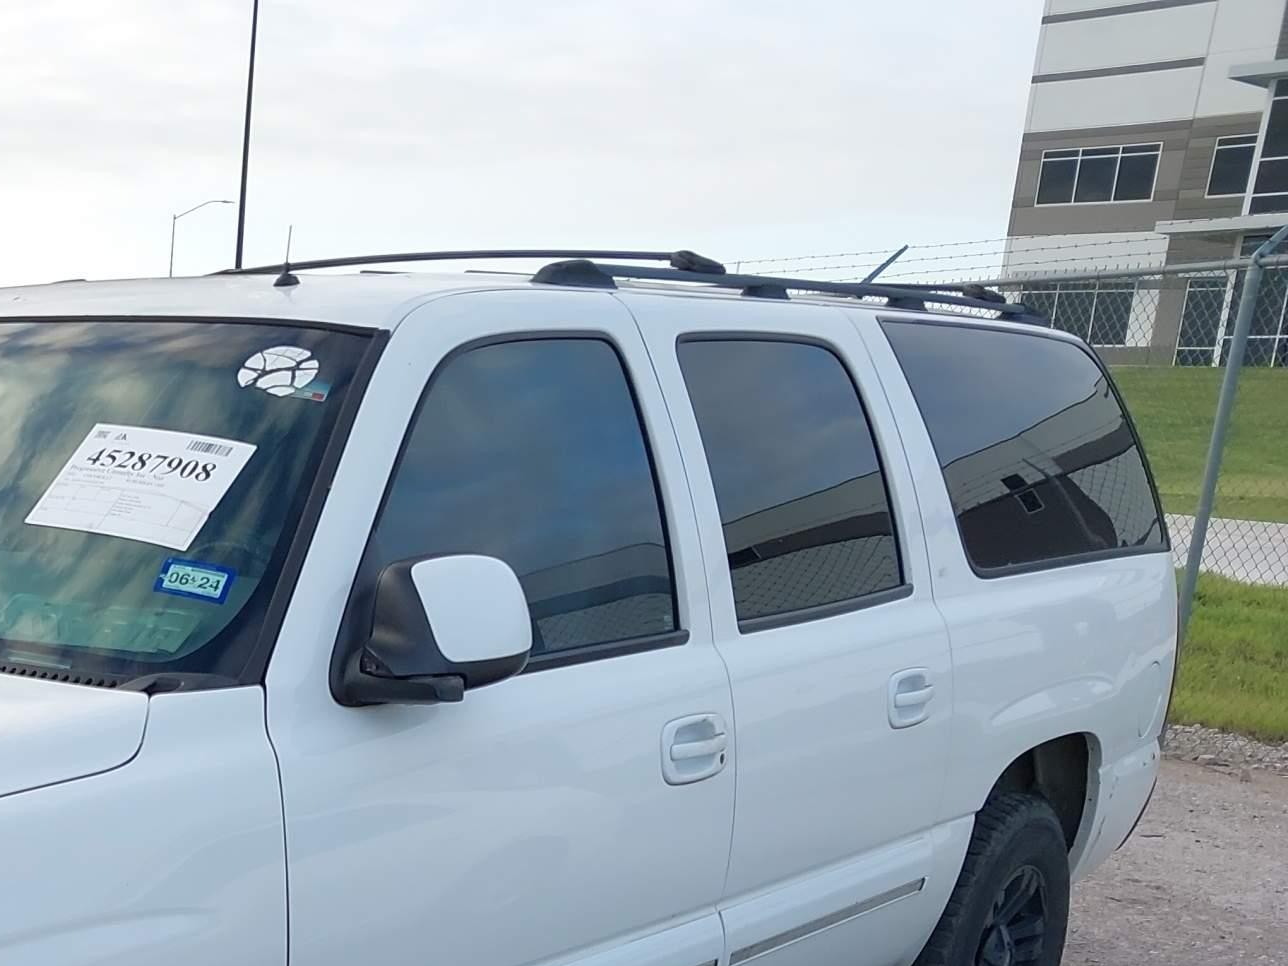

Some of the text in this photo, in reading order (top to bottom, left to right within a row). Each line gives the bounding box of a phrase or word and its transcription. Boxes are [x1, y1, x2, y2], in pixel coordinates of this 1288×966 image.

[86, 447, 217, 482] 45287908
[168, 572, 221, 592] 06 24
